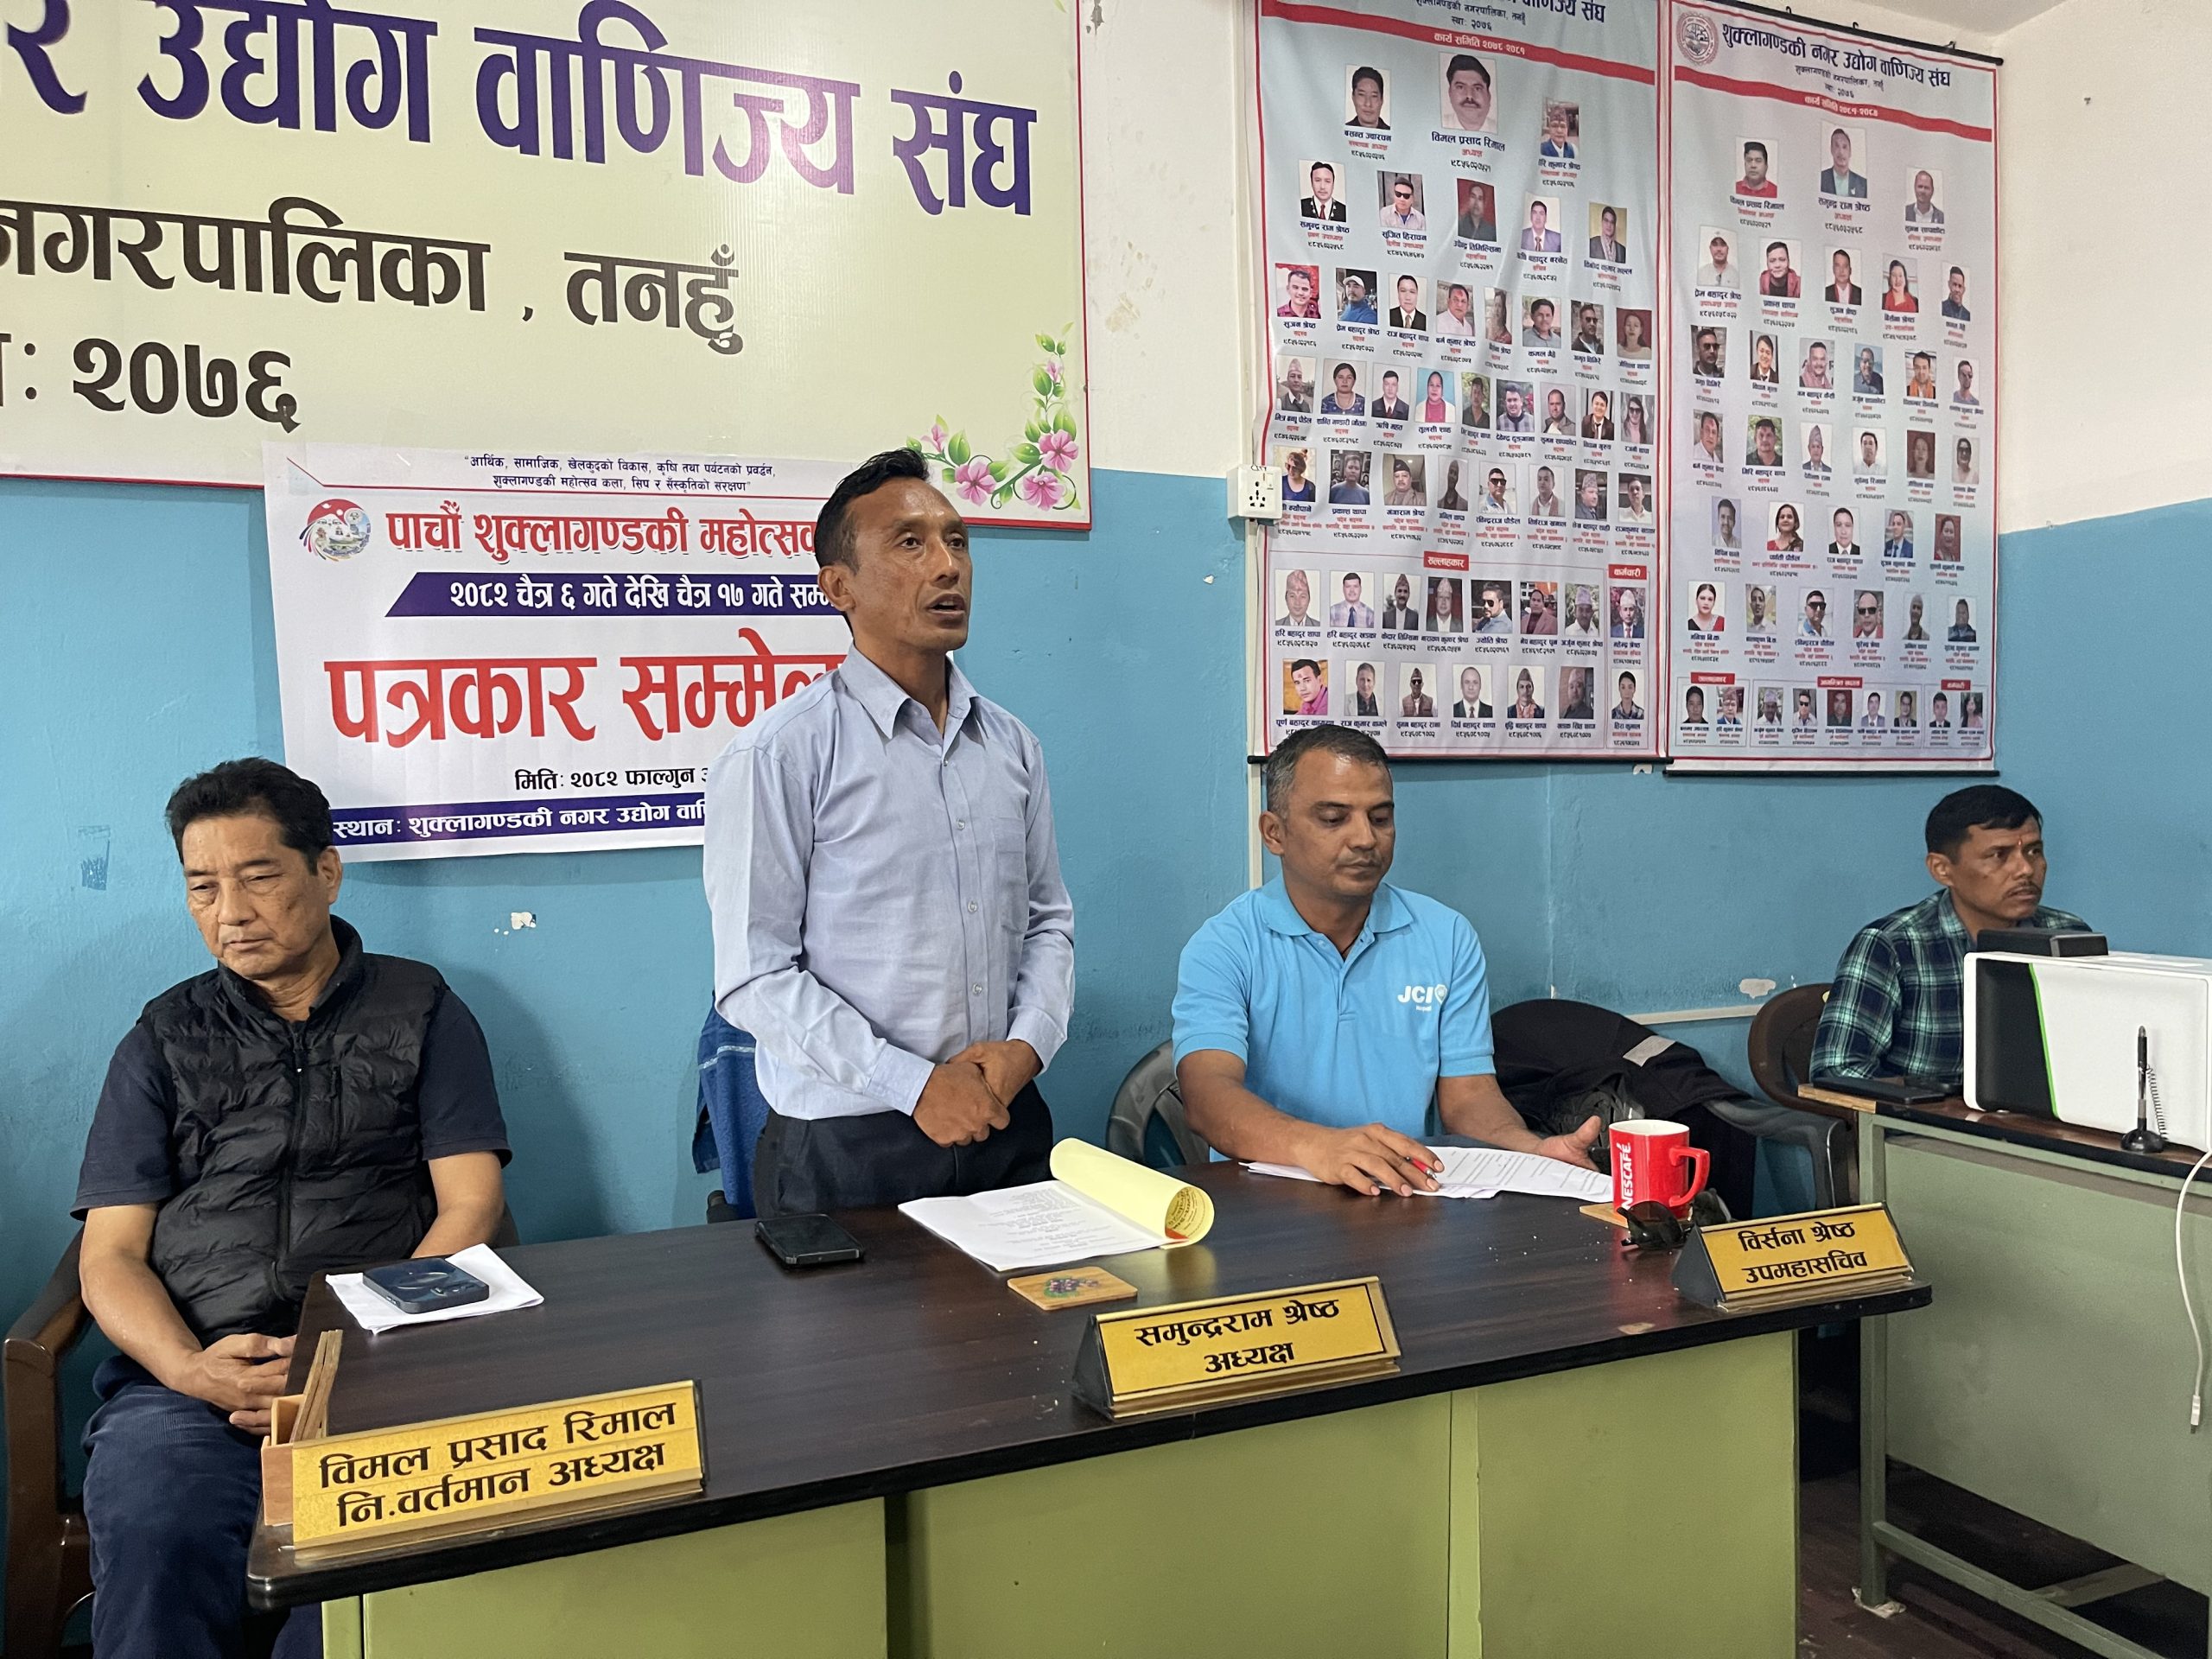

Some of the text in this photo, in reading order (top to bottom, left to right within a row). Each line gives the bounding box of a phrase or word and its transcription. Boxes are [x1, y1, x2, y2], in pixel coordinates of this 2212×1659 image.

[1454, 35, 1481, 48] समिति
[1471, 19, 1493, 32] २०७६
[1722, 23, 1806, 59] शुक्लागण्डकी
[1811, 43, 1840, 68] नगर
[1843, 49, 1878, 73] उद्योग
[1880, 56, 1924, 85] वाणिज्य
[1928, 67, 1951, 88] संघ
[137, 0, 438, 143] उद्योग
[474, 0, 861, 195] वाणिज्य
[891, 70, 1038, 217] संघ
[1432, 131, 1506, 152] विमल प्रसाद रिमाल
[563, 243, 744, 356] तनहुँ
[73, 337, 302, 434] २०७६
[493, 474, 556, 491] शुक्लागण्डकी
[561, 475, 597, 488] महोत्सव
[601, 477, 626, 490] कला,
[632, 476, 650, 489] सिप
[655, 480, 661, 490] र
[513, 457, 563, 472] सामाजिक,
[568, 458, 613, 474] खेलकुदको
[618, 460, 652, 474] विकास,
[657, 461, 678, 476] कृषि
[682, 462, 699, 474] तथा
[704, 462, 741, 475] पर्यटनको
[474, 506, 690, 563] शुक्लागण्डकी
[1427, 556, 1465, 568] सल्लाहकार
[449, 582, 510, 608] २०८२
[515, 574, 556, 611] चैत्र
[562, 582, 576, 612] ६
[582, 577, 619, 608] गते
[624, 576, 670, 610] देखि
[676, 575, 712, 610] चैत्र
[717, 582, 745, 608] १७
[751, 576, 785, 608] गते
[1274, 628, 1286, 638] हरि
[1287, 630, 1306, 640] बहादुर
[1327, 630, 1358, 640] हरि बहादुर
[324, 657, 598, 749] पत्रकार
[570, 773, 619, 788] २०८२
[626, 767, 695, 790] फाल्गुन
[409, 808, 554, 838] शुक्लागण्डकी
[560, 807, 610, 826] नगर
[616, 802, 671, 823] उद्योग
[1396, 985, 1434, 1003] JCI
[1620, 1141, 1634, 1210] NESCAFÉ
[1738, 1221, 1857, 1253] विर्सना श्रेष्ठ
[1741, 1249, 1869, 1285] उपमहासचिव
[1134, 1299, 1341, 1347] समुन्द्रराम श्रेष्ठ
[1204, 1341, 1296, 1374] अध्यक्ष
[320, 1402, 677, 1490] विमल प्रसाद रिमाल
[336, 1441, 667, 1529] नि.वर्तमान अध्यक्ष
